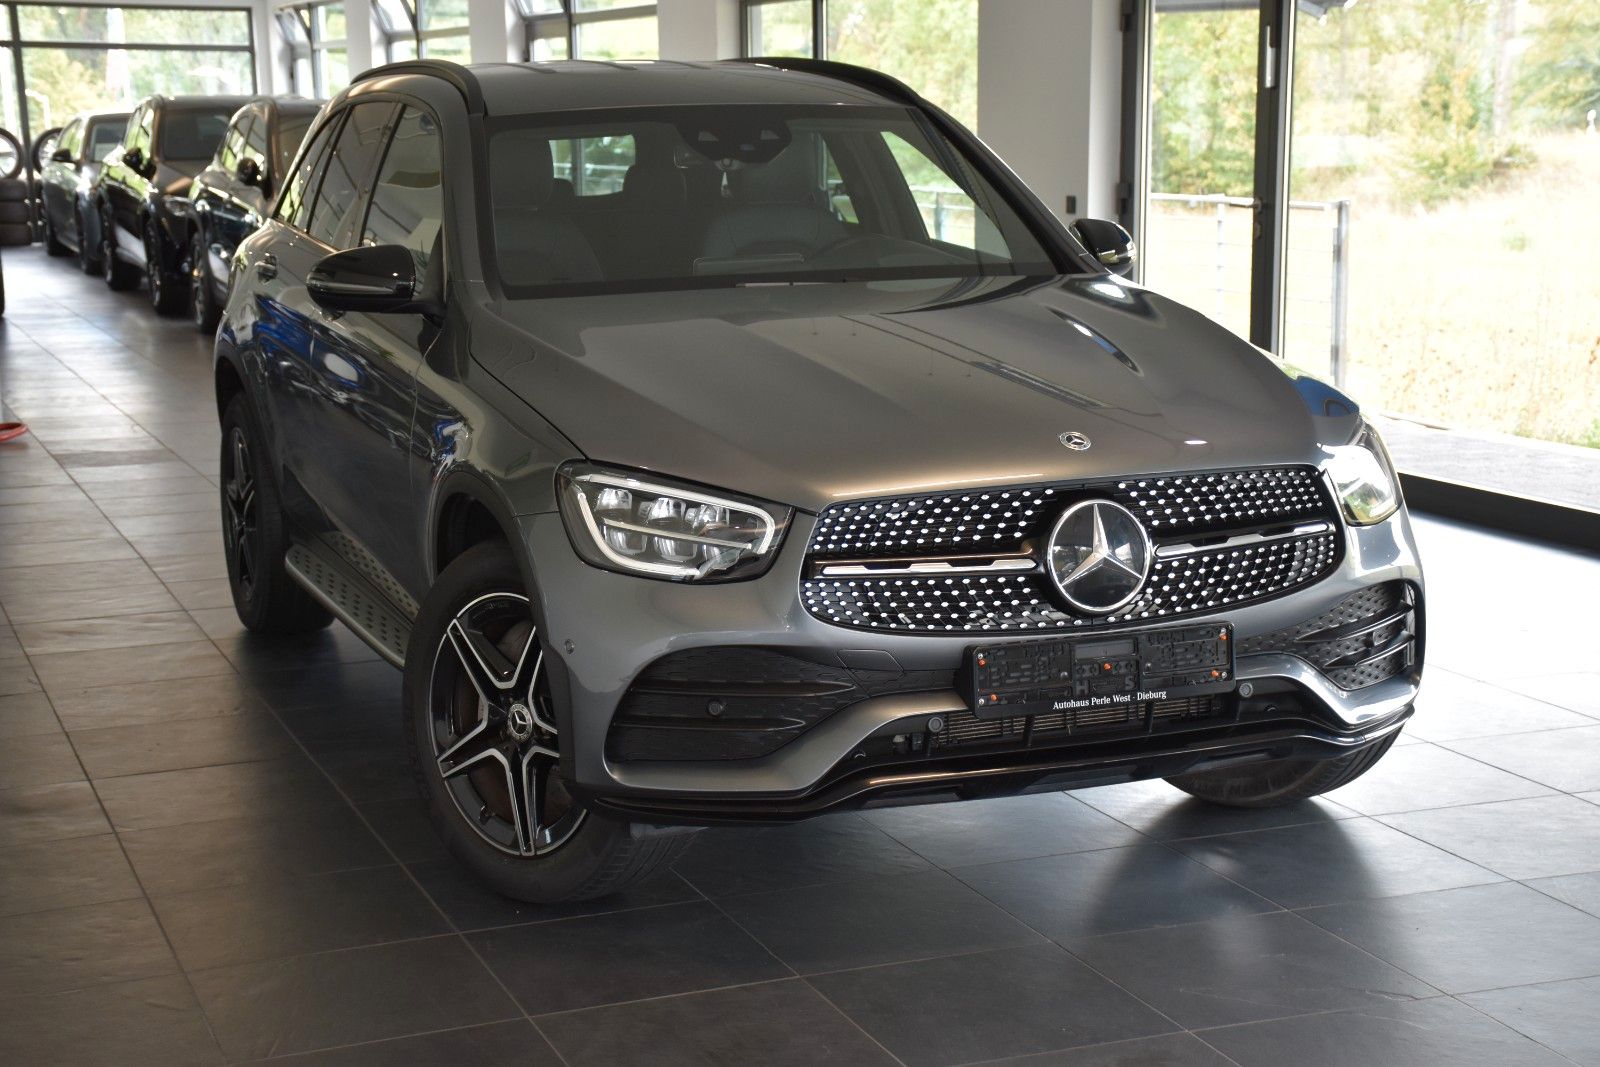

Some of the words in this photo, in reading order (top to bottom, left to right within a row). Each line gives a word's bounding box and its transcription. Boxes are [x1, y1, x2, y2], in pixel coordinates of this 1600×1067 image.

[1053, 699, 1090, 710] Autohaus
[1091, 695, 1111, 706] Perle
[1112, 694, 1131, 703] West
[1137, 690, 1167, 700] Dieburg
